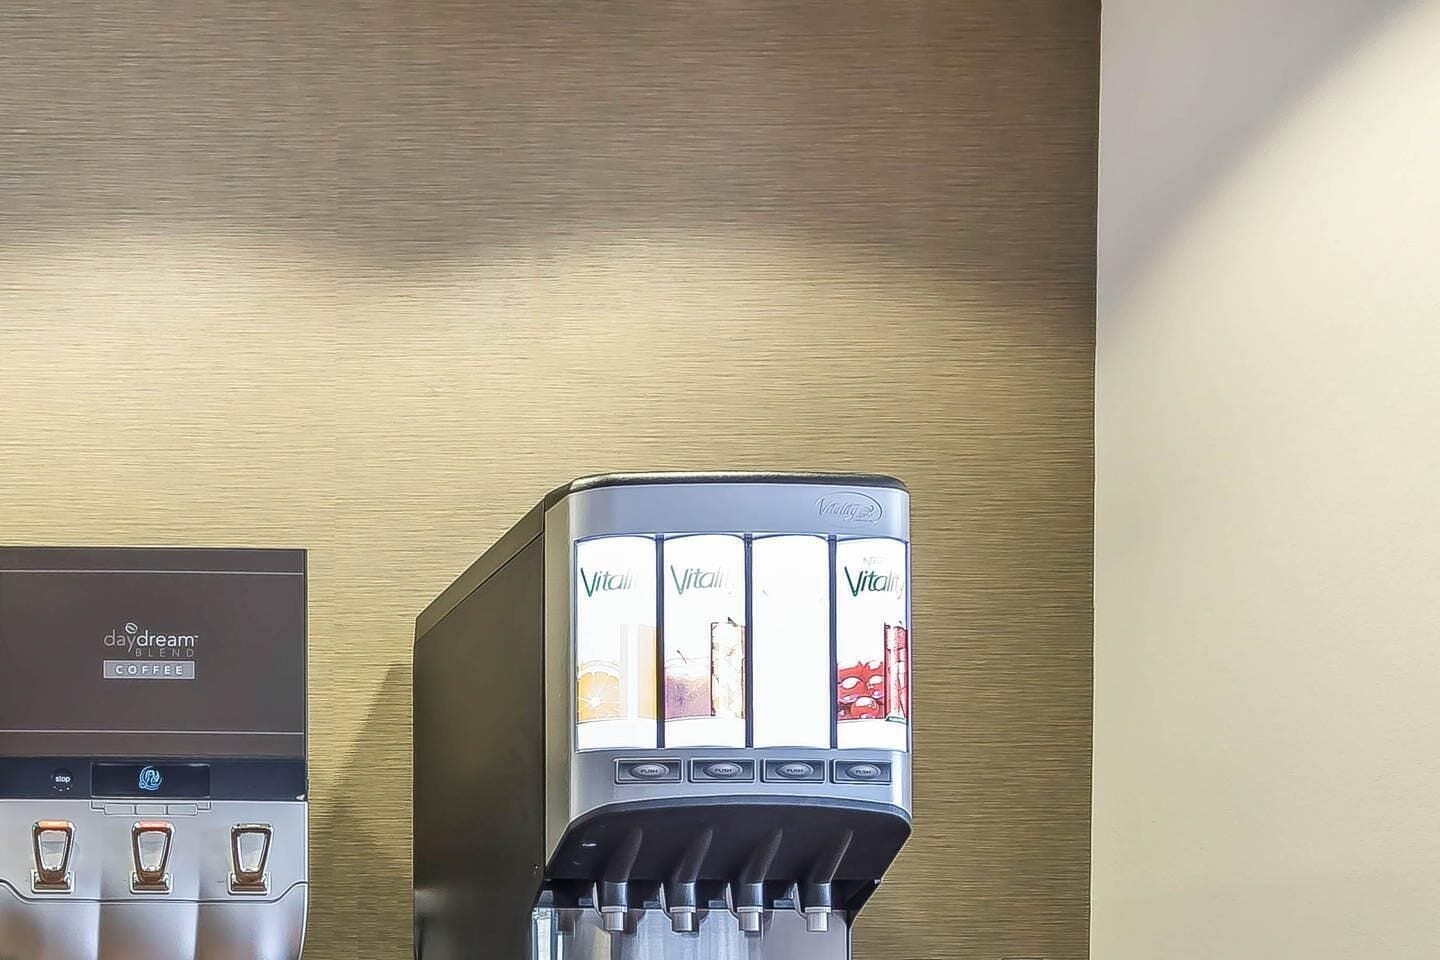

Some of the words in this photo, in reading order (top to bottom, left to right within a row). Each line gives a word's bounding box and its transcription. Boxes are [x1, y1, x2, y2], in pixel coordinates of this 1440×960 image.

[135, 648, 195, 658] BLEND
[115, 665, 184, 675] COFFEE
[55, 775, 71, 784] stop
